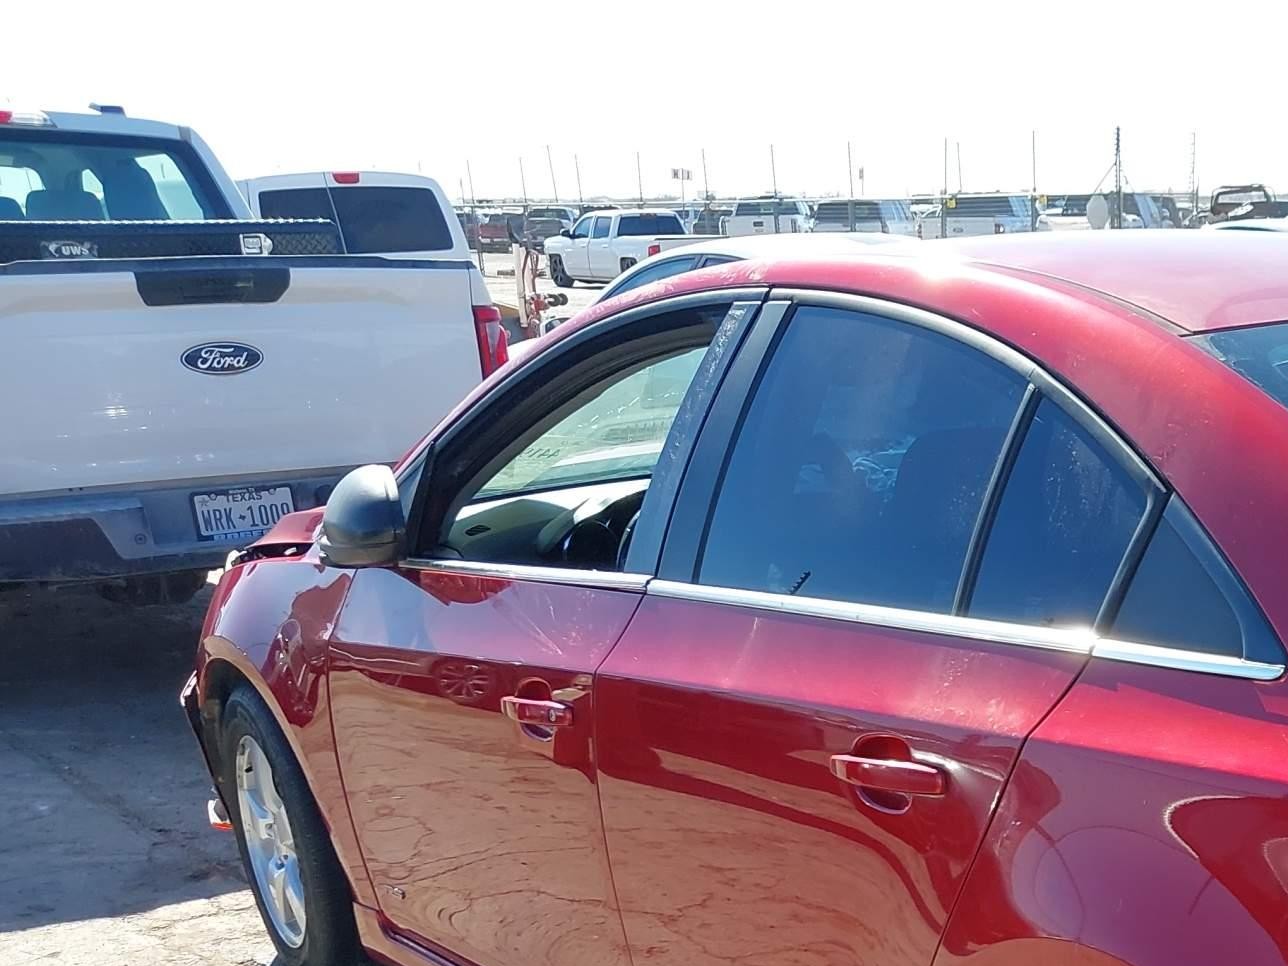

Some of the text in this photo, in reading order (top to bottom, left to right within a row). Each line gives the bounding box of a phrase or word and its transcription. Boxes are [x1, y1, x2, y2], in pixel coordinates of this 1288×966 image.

[62, 245, 89, 256] UWS
[197, 347, 249, 369] Ford
[226, 491, 263, 503] TEXAS
[201, 506, 237, 532] WRK
